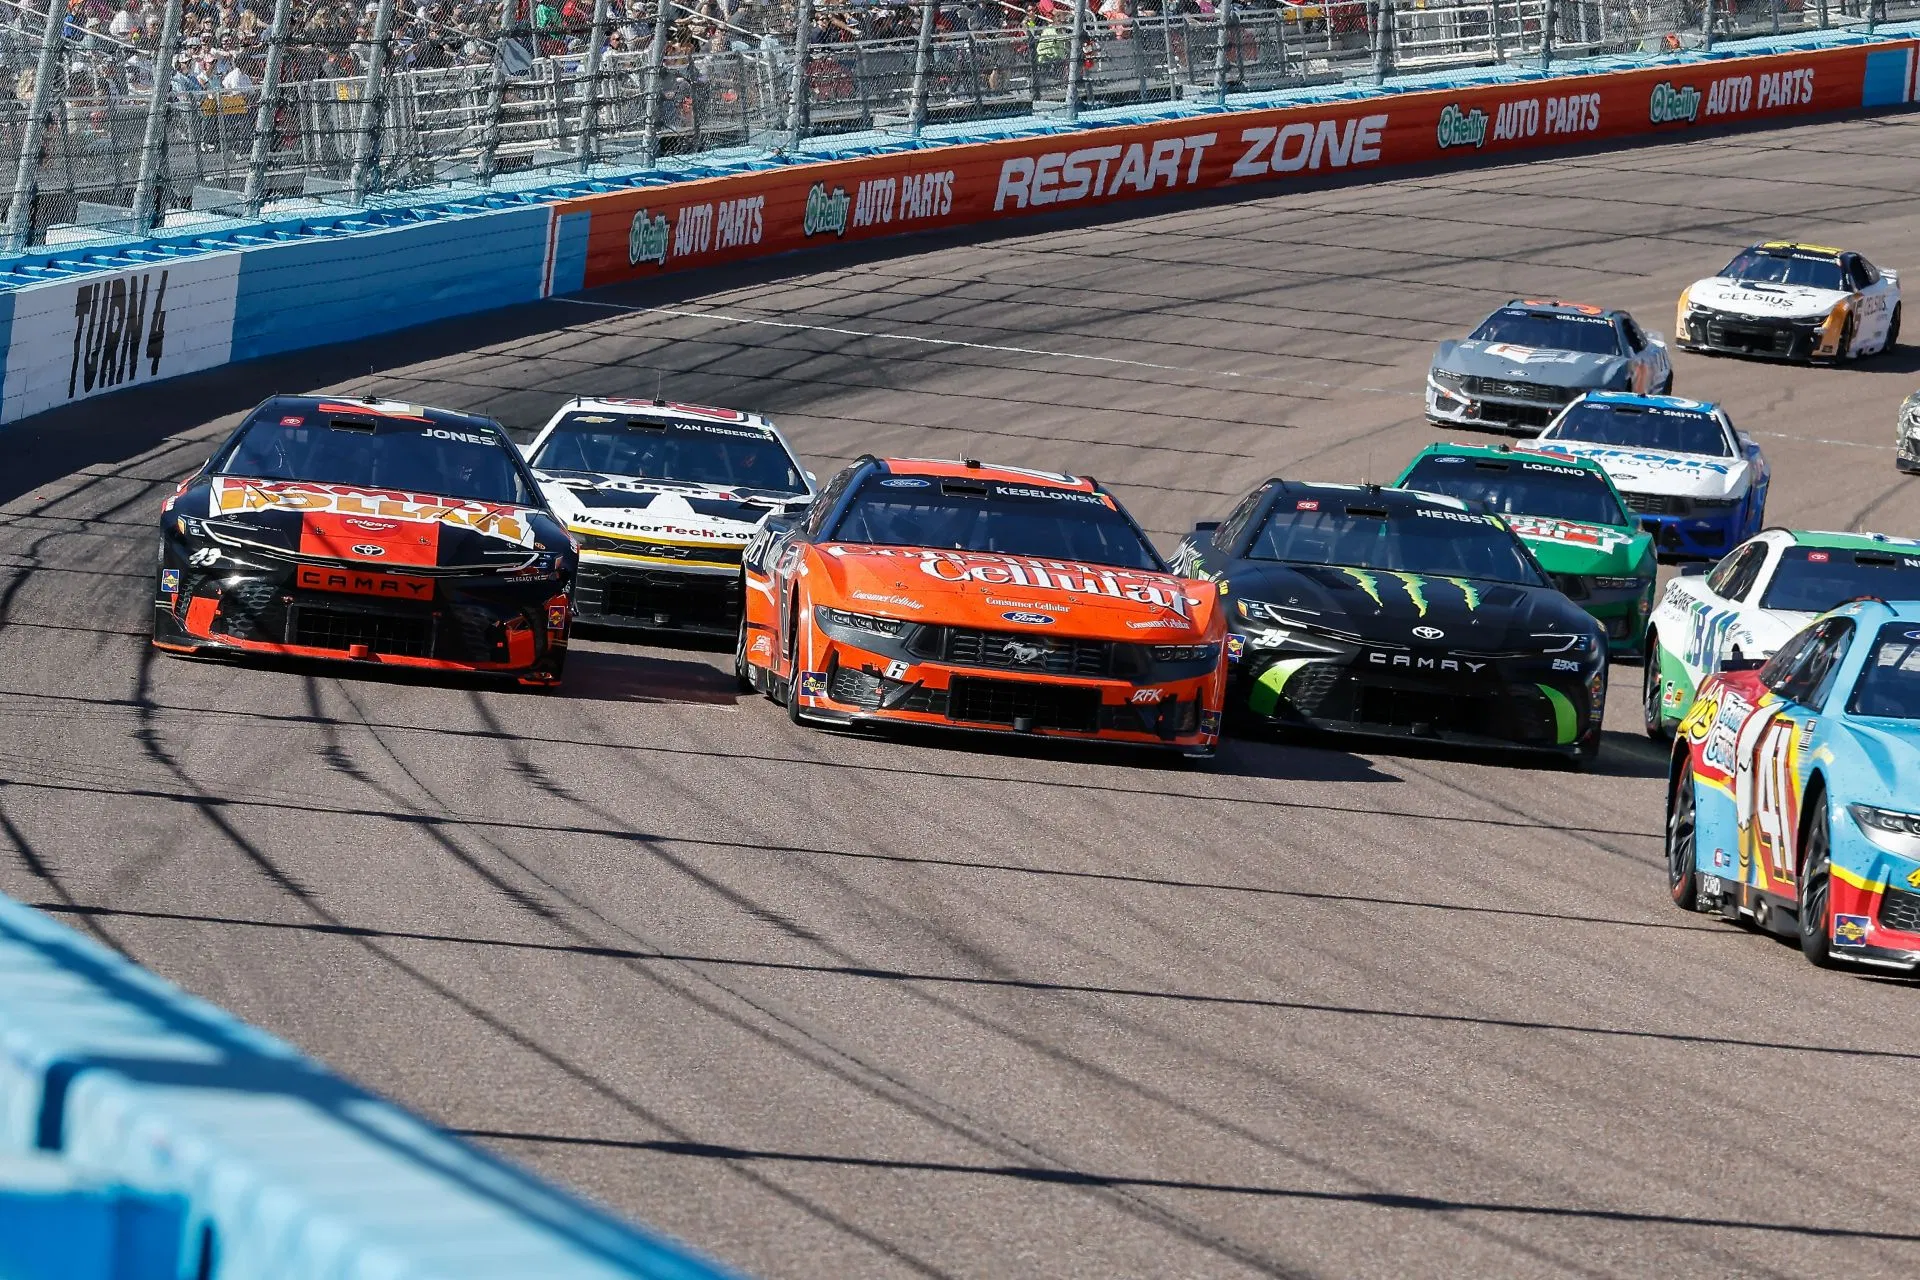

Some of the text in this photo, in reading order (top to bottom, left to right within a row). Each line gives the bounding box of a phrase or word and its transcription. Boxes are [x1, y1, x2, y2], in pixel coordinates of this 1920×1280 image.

[1705, 75, 1752, 115] AUTO
[1757, 68, 1814, 109] PARTS
[1494, 101, 1539, 141] AUTO
[1545, 92, 1600, 134] PARTS
[994, 114, 1388, 211] RESTART ZONE
[853, 179, 897, 227] AUTO
[899, 170, 955, 219] PARTS
[673, 207, 714, 256] AUTO
[715, 196, 764, 251] PARTS
[1719, 292, 1795, 308] CELSIUS
[69, 270, 168, 399] TURN 4
[1663, 410, 1702, 420] SMITH
[421, 428, 496, 446] JONES
[675, 423, 702, 431] VAN
[1522, 463, 1585, 477] LOGANO
[1646, 462, 1700, 475] Own
[221, 488, 522, 541] DOLLAR
[346, 518, 398, 530] Colgate
[1416, 509, 1492, 526] HERBST
[189, 547, 222, 567] 43
[302, 570, 428, 595] CAMRY
[919, 557, 1201, 620] Cellular
[852, 589, 924, 610] Consumer Cellular
[985, 596, 1071, 613] Consumer Cellular
[1009, 612, 1047, 624] Ford
[1252, 627, 1291, 648] 35
[885, 659, 910, 680] 6
[1369, 652, 1486, 673] CAMRY
[1757, 724, 1794, 871] 41
[1703, 874, 1721, 896] FORD
